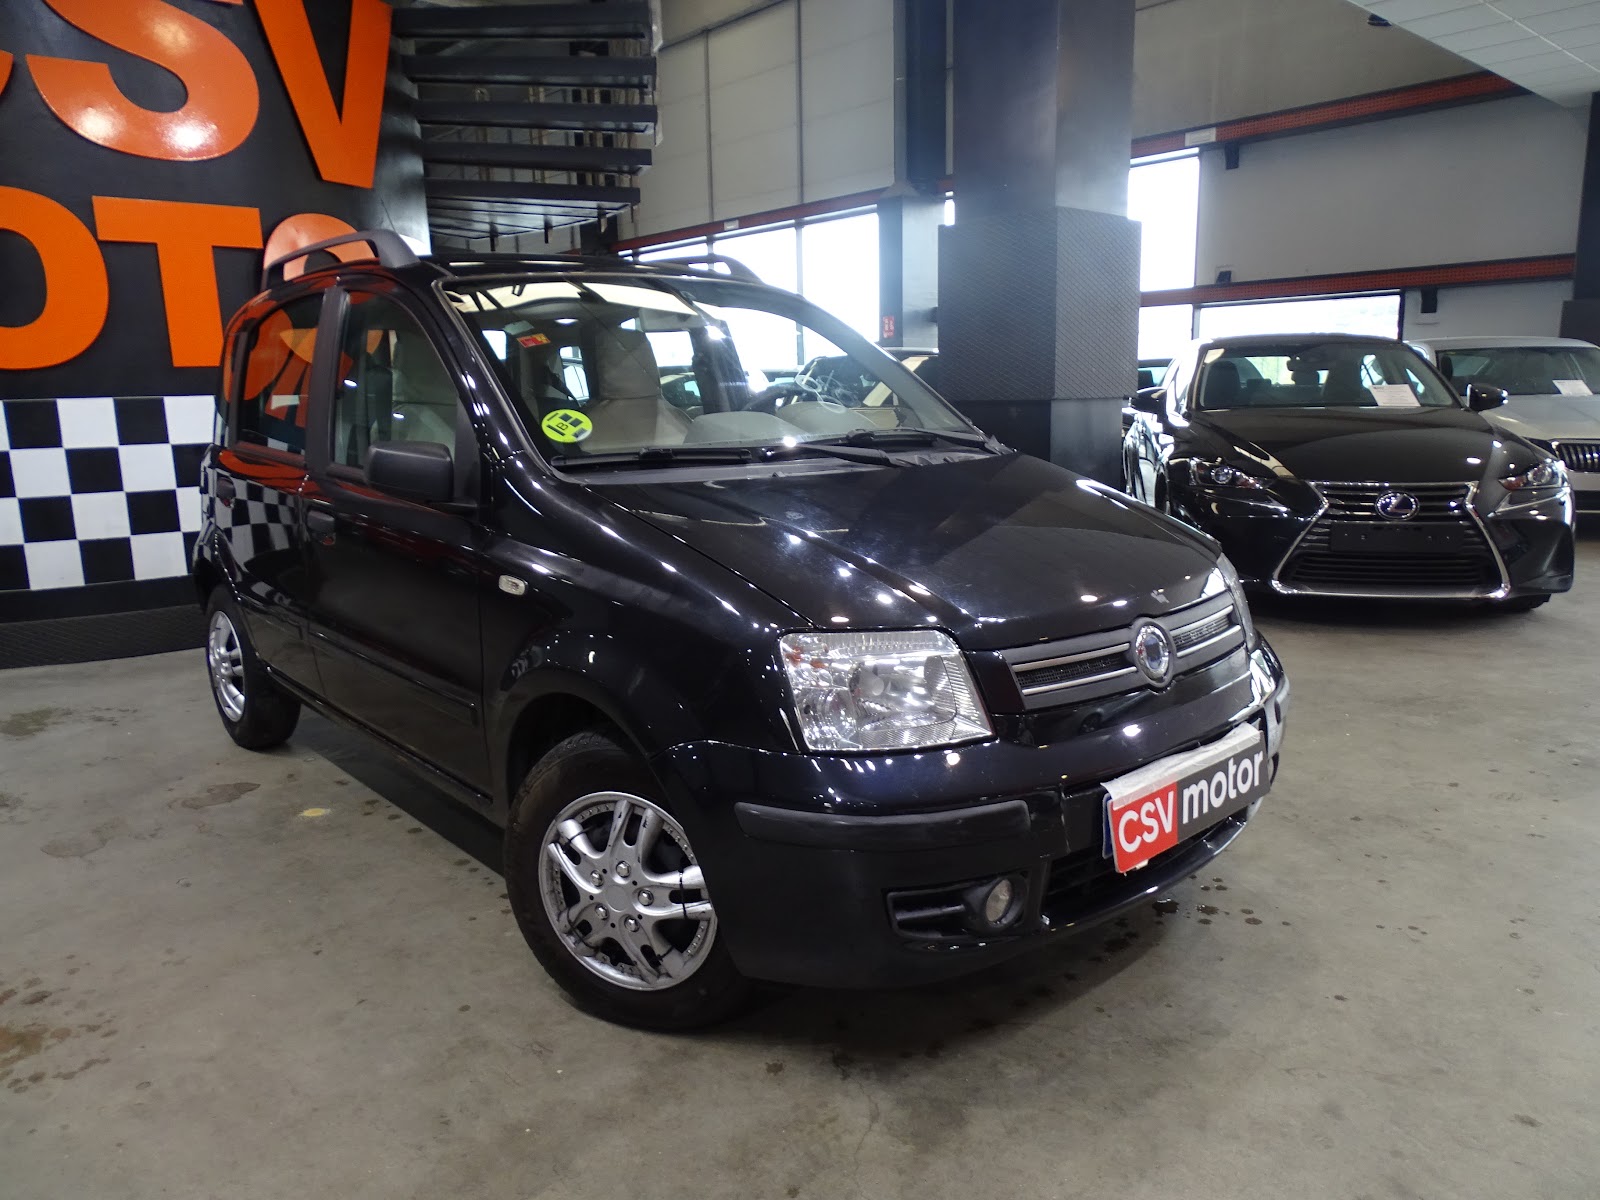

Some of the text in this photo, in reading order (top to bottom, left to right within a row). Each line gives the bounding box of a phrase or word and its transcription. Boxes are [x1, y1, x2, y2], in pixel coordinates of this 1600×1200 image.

[0, 0, 392, 189] SV
[1118, 750, 1264, 853] CSV motor
